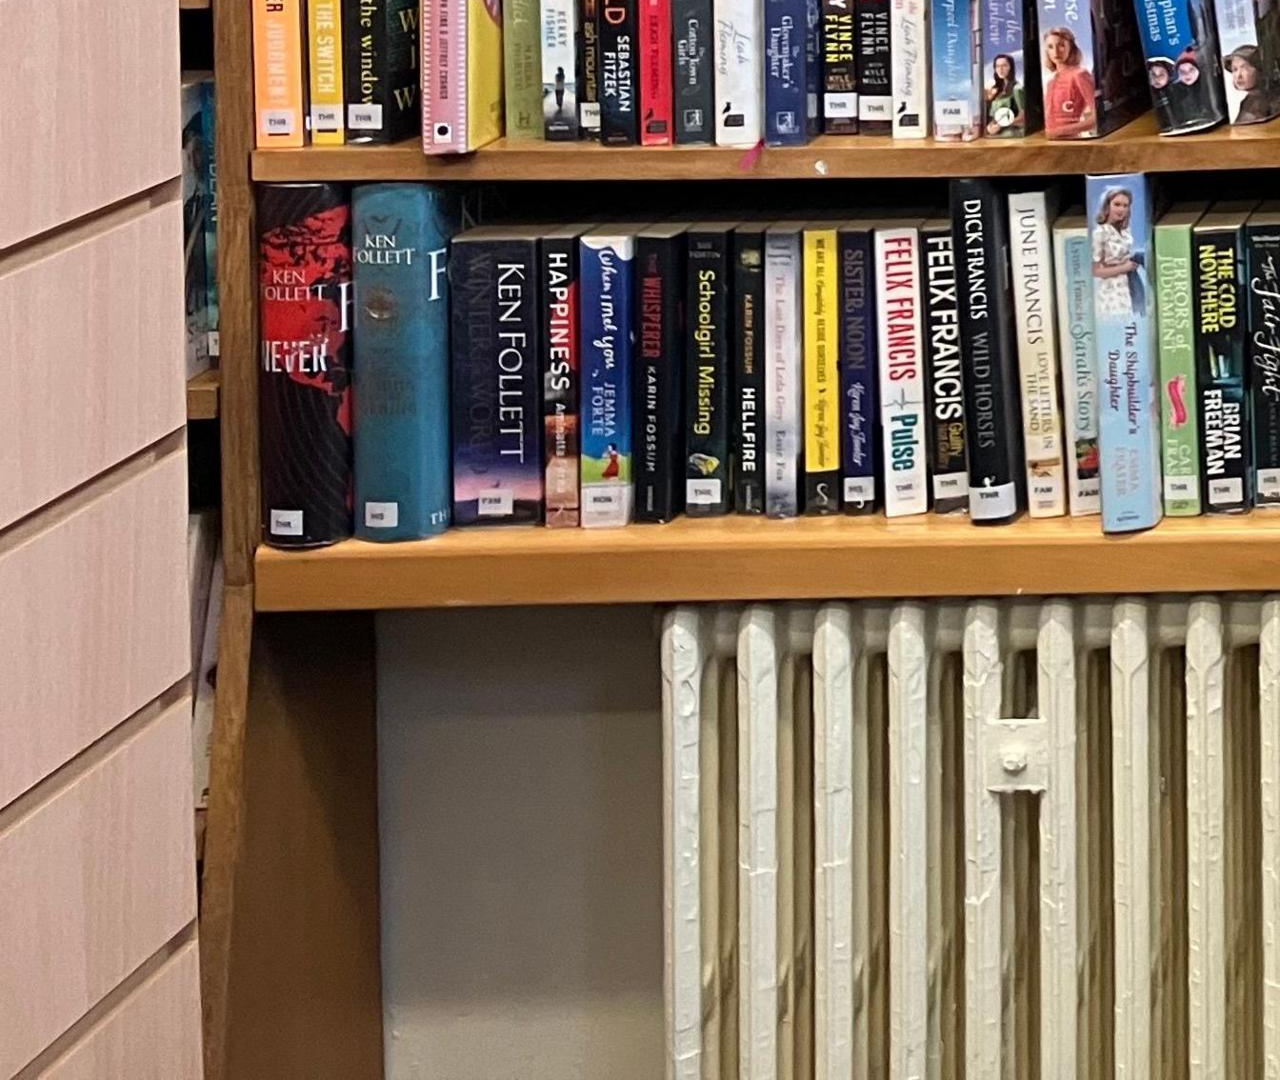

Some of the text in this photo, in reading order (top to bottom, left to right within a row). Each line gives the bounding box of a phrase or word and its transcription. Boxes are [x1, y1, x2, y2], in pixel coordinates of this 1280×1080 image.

[604, 51, 616, 97] FITZEK
[547, 253, 570, 391] HAPPINESS
[694, 269, 714, 359] Schoolgirl
[884, 236, 916, 381] FELIX FRANCIS
[498, 262, 527, 463] KEN FOLLETT
[890, 413, 918, 472] Pulse
[1204, 389, 1222, 475] FREEMAN
[1222, 403, 1240, 459] BRIAN
